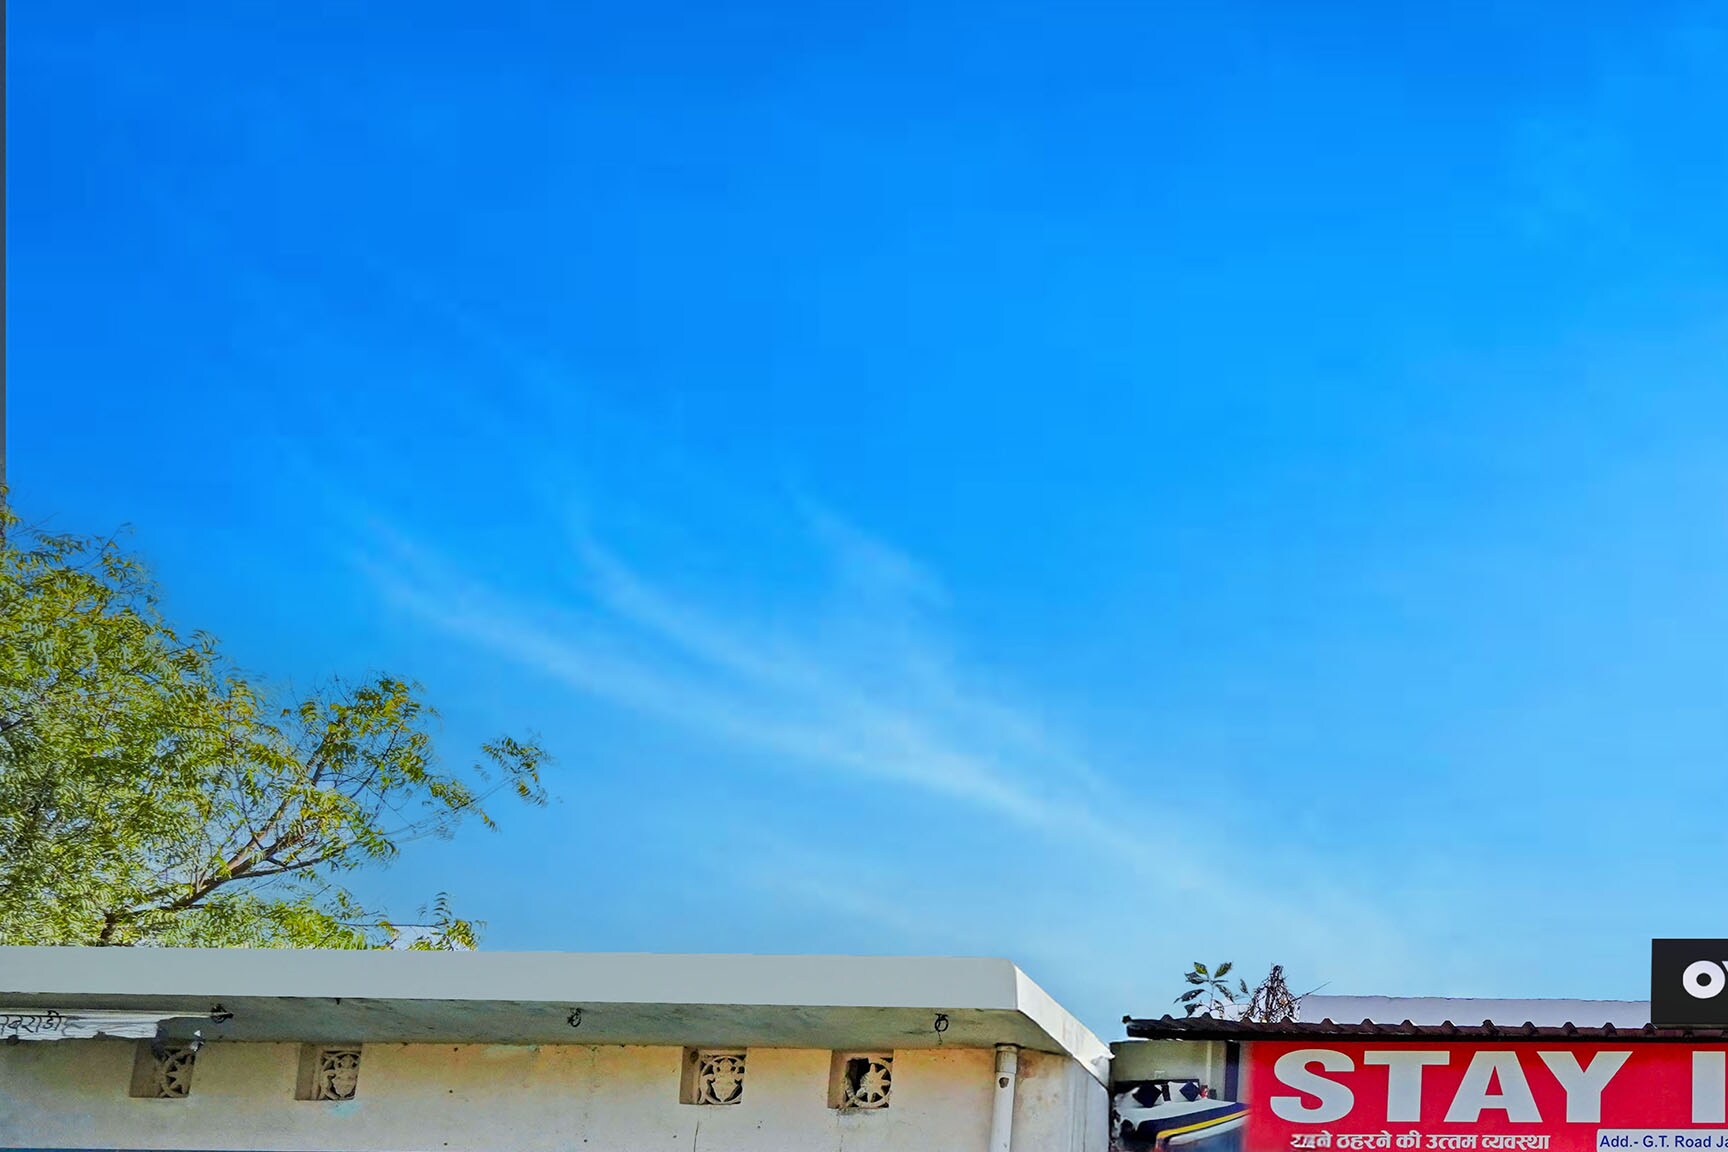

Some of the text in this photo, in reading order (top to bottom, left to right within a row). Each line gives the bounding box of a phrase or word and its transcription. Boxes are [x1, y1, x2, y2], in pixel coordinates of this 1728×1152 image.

[1270, 1049, 1633, 1124] STAY
[1336, 1130, 1392, 1150] ठहरने
[1395, 1130, 1423, 1149] की
[1425, 1134, 1478, 1150] उत्तम
[1481, 1134, 1550, 1151] व्यवस्था
[1600, 1135, 1639, 1148] Add.-
[1642, 1135, 1670, 1148] G.T.
[1674, 1135, 1712, 1148] Road
